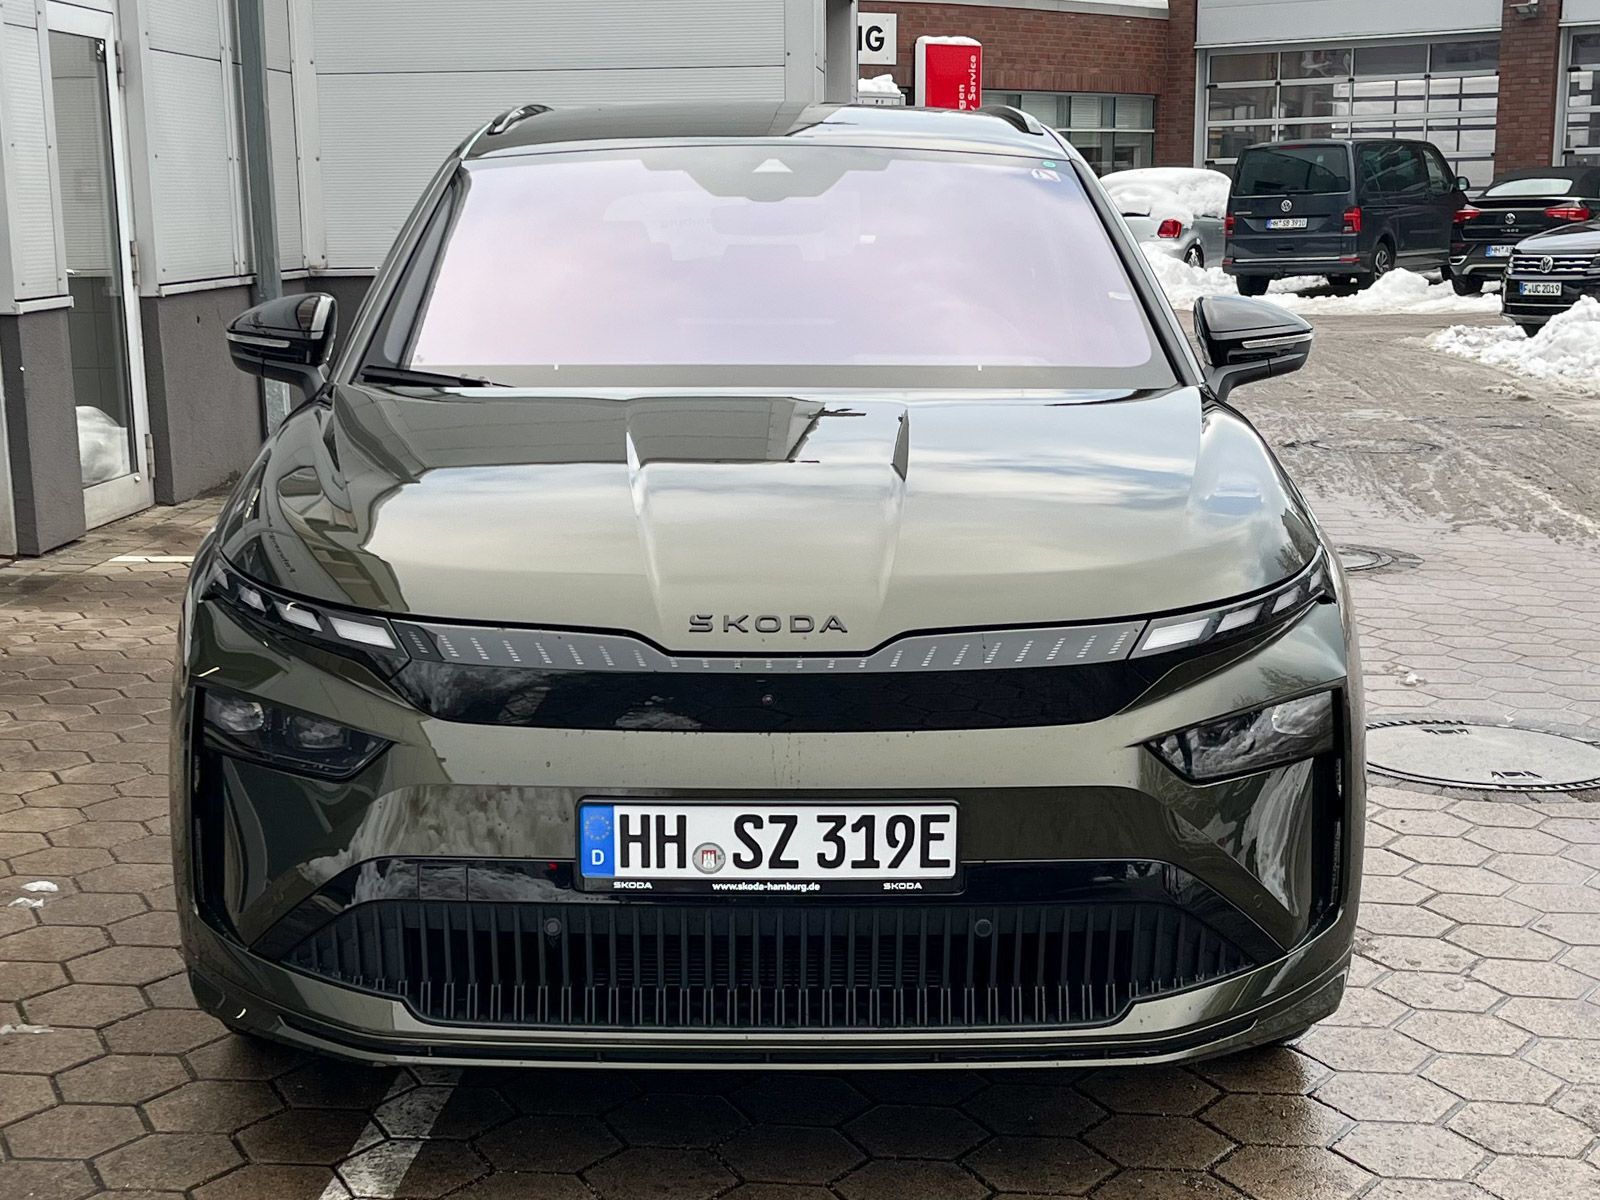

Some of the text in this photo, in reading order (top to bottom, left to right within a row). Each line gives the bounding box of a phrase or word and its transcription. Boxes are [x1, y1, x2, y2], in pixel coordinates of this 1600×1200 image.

[967, 55, 976, 101] Service
[1531, 284, 1541, 294] UC
[1542, 284, 1560, 293] 2019
[619, 814, 950, 869] HH SZ 319E
[591, 850, 605, 866] D
[712, 882, 821, 892] www.skoda-hamburg.de
